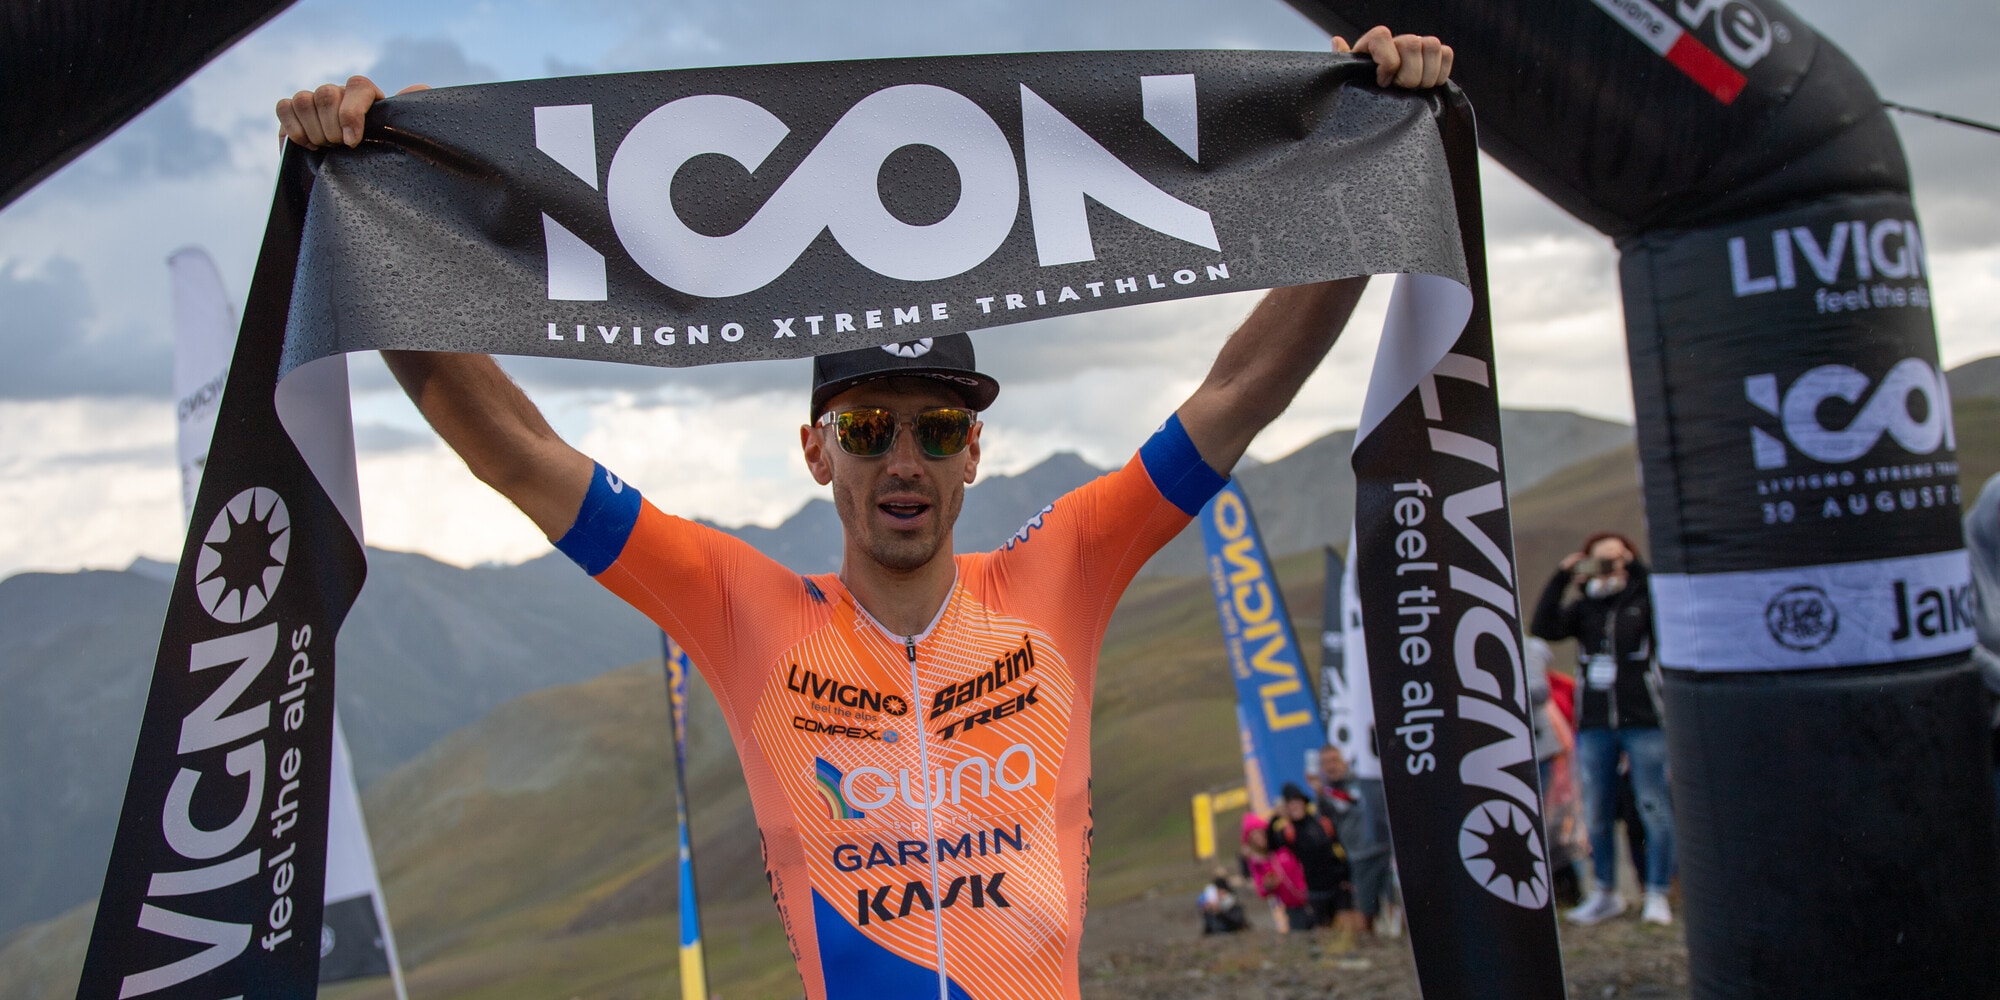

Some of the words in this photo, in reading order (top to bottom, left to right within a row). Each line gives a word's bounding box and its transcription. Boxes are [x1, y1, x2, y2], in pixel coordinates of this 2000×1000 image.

[534, 74, 1221, 300] ICON
[1727, 218, 1927, 297] LIVIGN
[547, 321, 744, 346] LIVIGNO
[773, 302, 949, 338] XTREME
[976, 263, 1230, 315] TRIATHLON
[1816, 283, 1869, 314] feel
[1871, 283, 1907, 308] the
[1744, 357, 1956, 470] ICO
[1757, 471, 1854, 495] LIVIGNO
[1761, 501, 1795, 524] 30
[1822, 484, 1946, 519] AUGUST
[1394, 478, 1438, 572] feel
[1399, 587, 1441, 666] the
[1418, 353, 1549, 910] LIVIGNO
[280, 623, 312, 732] alps
[787, 664, 908, 717] LIVIGNO
[811, 701, 831, 714] feel
[834, 706, 852, 718] the
[855, 712, 878, 723] alps
[930, 634, 1036, 721] Santini
[937, 685, 1039, 741] TREK
[793, 716, 880, 740] COMPEX
[1395, 686, 1444, 775] alps
[271, 746, 302, 839] the
[893, 811, 974, 833] sport
[833, 824, 1024, 872] GARMIN
[262, 842, 296, 951] feel
[858, 872, 1010, 926] KASK
